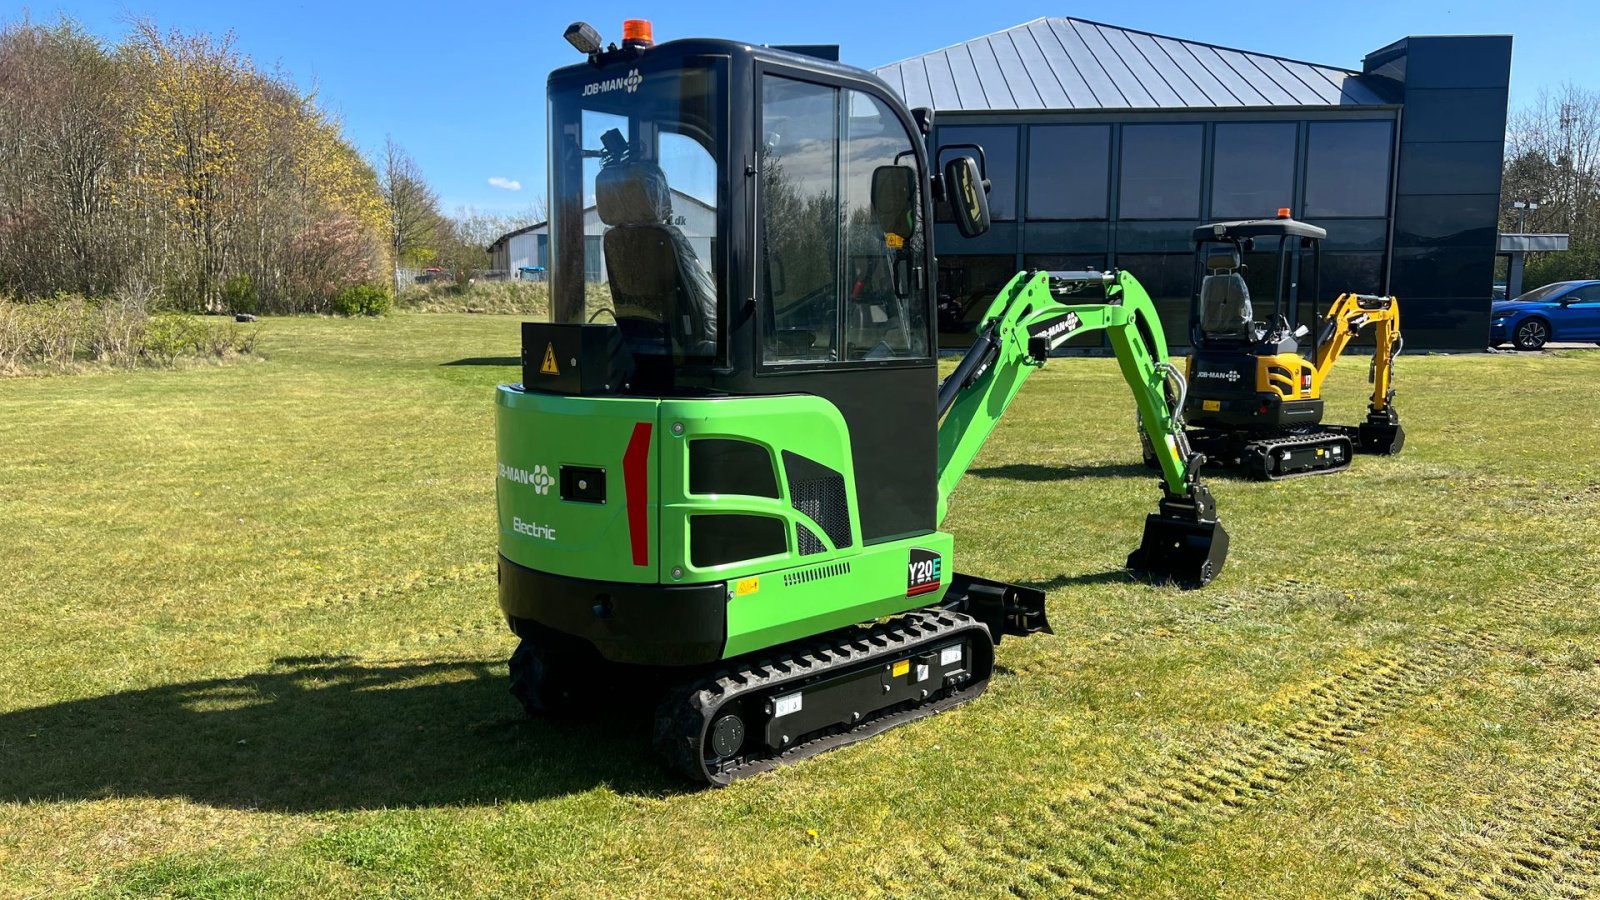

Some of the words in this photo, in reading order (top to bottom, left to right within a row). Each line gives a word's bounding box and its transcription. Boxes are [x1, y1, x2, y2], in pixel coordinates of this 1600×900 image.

[582, 77, 623, 97] JOB-MAN
[1197, 371, 1226, 379] JOB-MAN
[513, 516, 556, 541] Electric
[908, 557, 941, 581] Y20E
